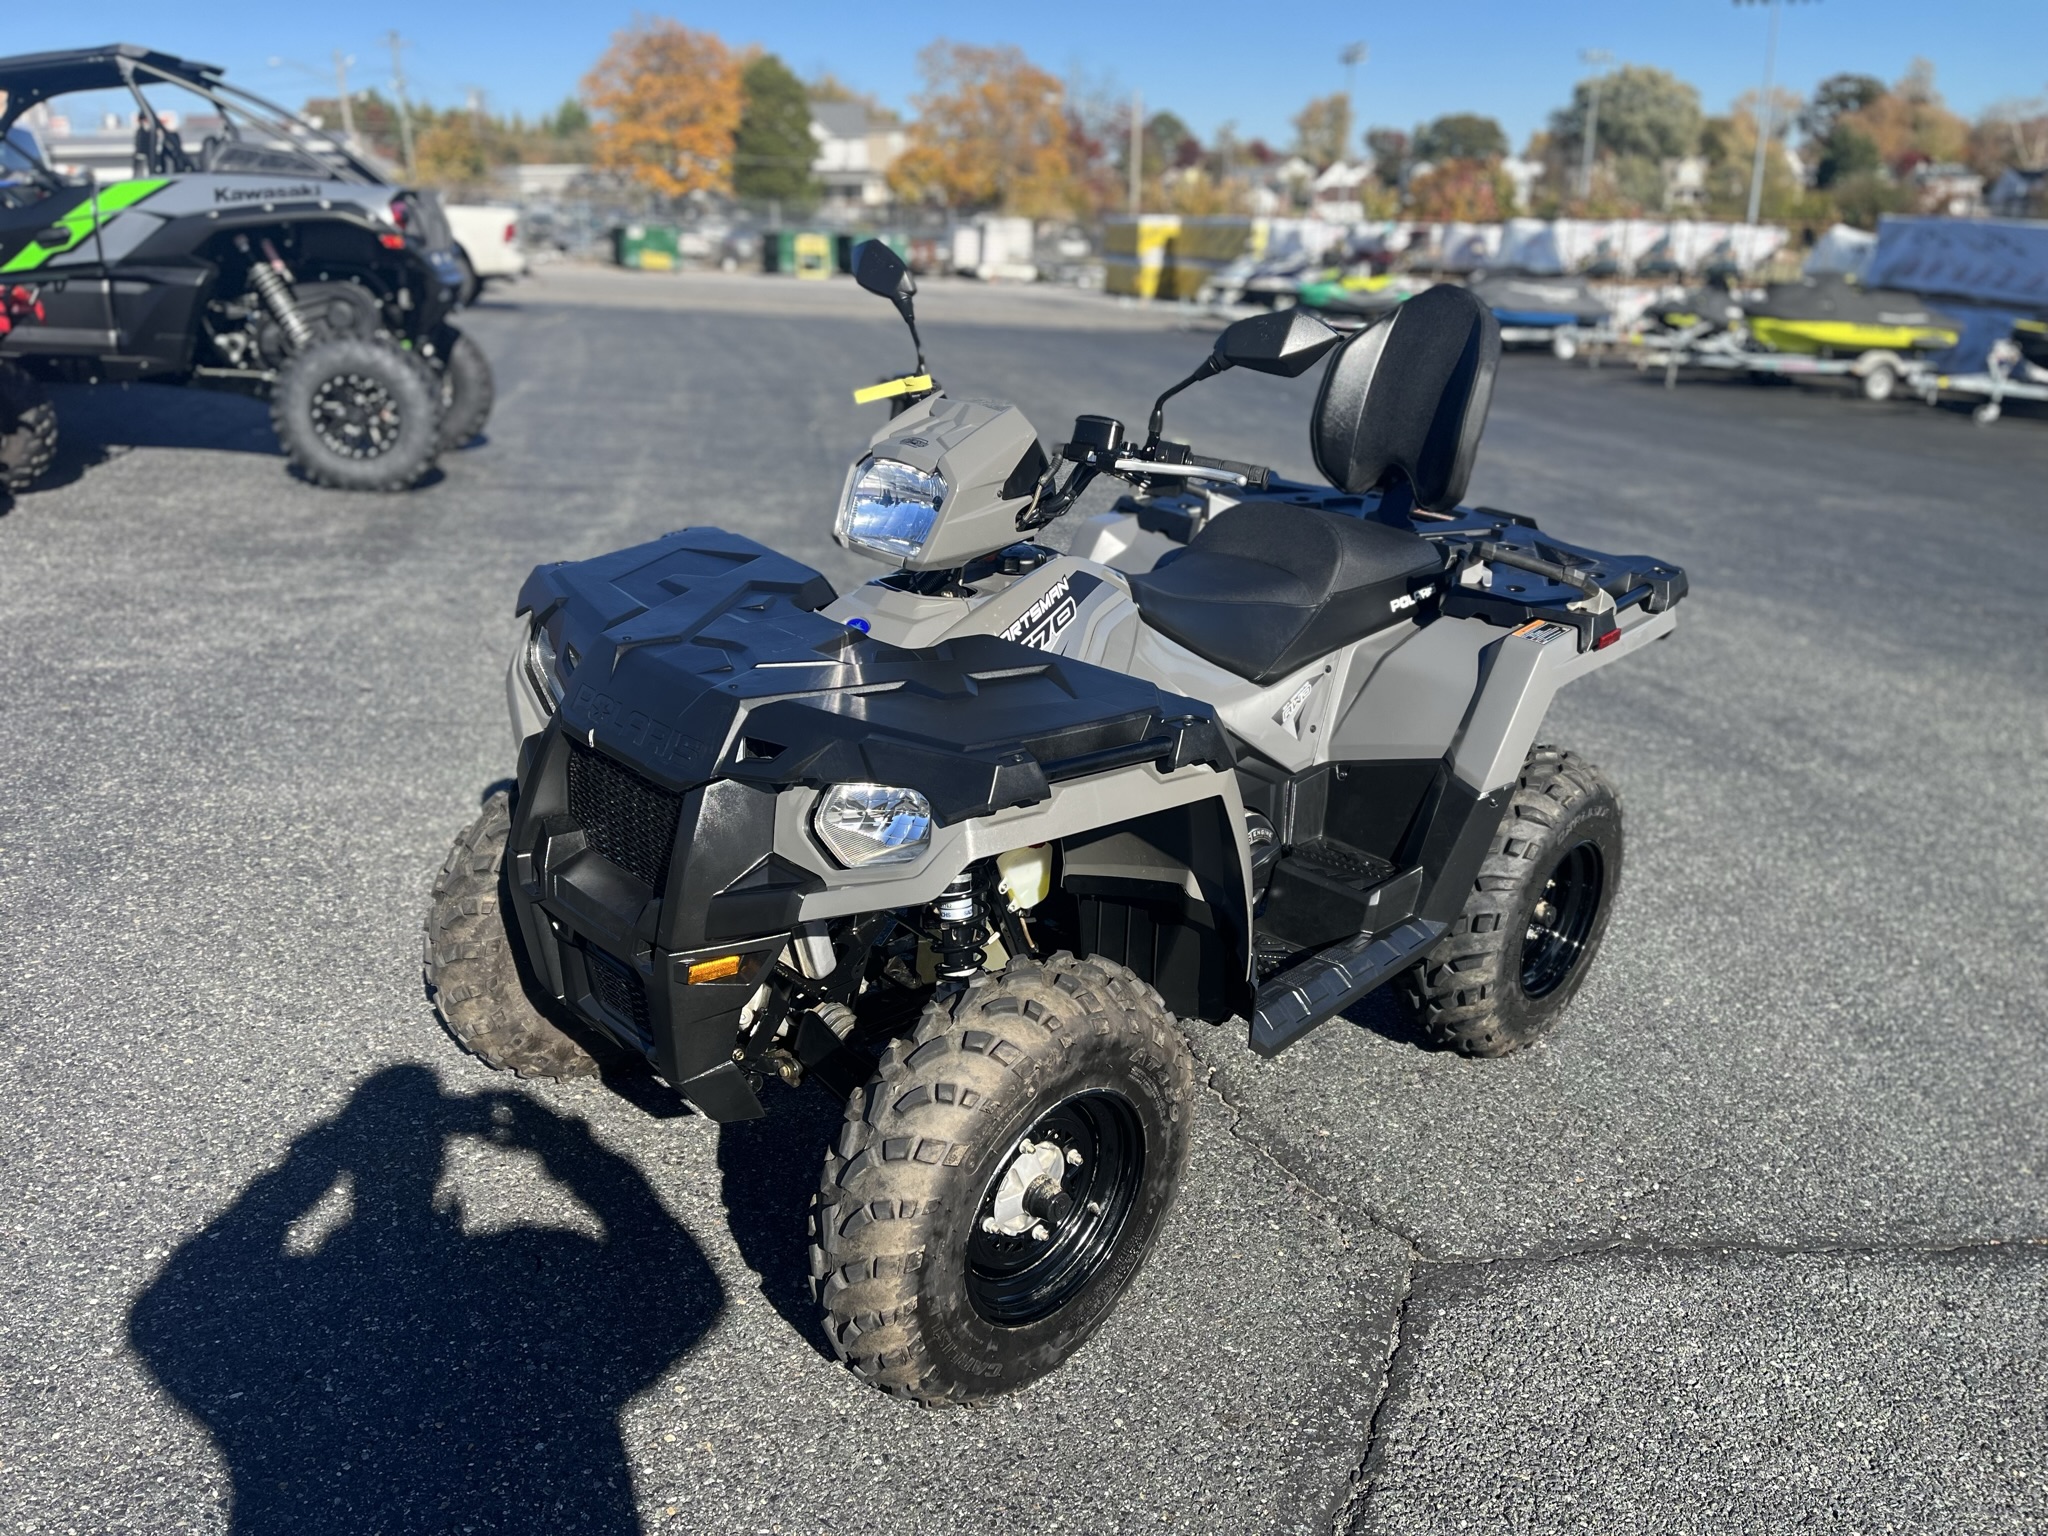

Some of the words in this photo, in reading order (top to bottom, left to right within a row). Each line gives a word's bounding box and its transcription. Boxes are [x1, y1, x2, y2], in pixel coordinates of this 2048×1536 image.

[214, 183, 321, 203] Kawasaki
[1020, 594, 1077, 651] 70
[571, 682, 705, 762] POLARIS
